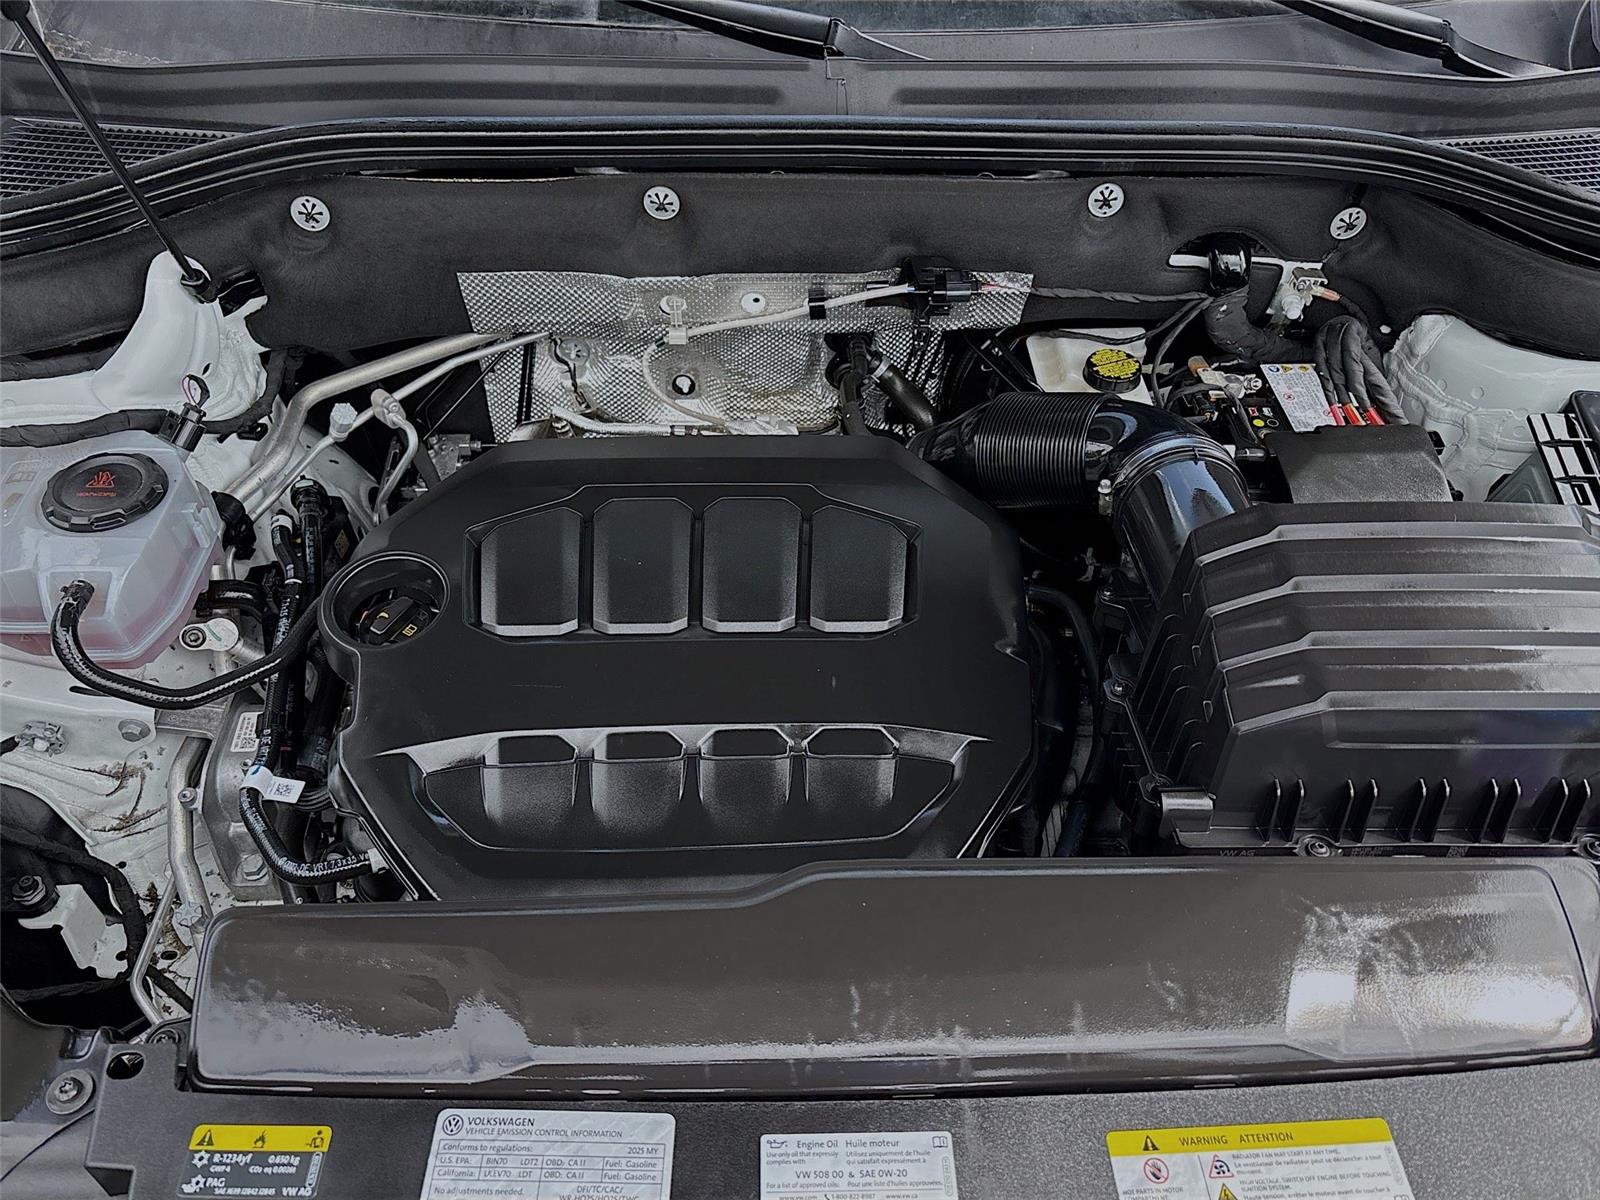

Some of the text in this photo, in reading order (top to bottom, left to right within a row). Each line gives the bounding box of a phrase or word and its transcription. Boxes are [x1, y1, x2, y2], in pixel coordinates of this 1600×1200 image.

[467, 1116, 535, 1127] VOLKSWAGEN
[465, 1127, 623, 1138] VEHICLE EMISSION CONTROL INFORMATION
[845, 1139, 900, 1148] Huile moteur
[1179, 1132, 1294, 1147] WARNING ATTENTION
[442, 1142, 533, 1153] Conforms to regulations:
[797, 1140, 838, 1150] Engine Oil
[628, 1146, 659, 1155] 2025 MY
[779, 1151, 790, 1159] only
[213, 1153, 253, 1166] R-1234yf
[290, 1155, 301, 1166] kg
[440, 1156, 472, 1165] U.S. EPA:
[485, 1157, 538, 1166] BIN70 LDT2
[545, 1159, 564, 1167] OBD:
[605, 1160, 657, 1169] Fuel: Gasoline
[437, 1168, 475, 1177] California:
[484, 1170, 533, 1178] ULEV70 LDT
[543, 1171, 563, 1179] OBD:
[603, 1172, 657, 1181] Fuel: Gasoline
[795, 1171, 812, 1179] VW
[813, 1170, 830, 1179] 508
[831, 1170, 844, 1179] 00
[859, 1169, 877, 1178] SAE
[878, 1169, 908, 1178] 0W-20
[206, 1177, 226, 1187] PAG
[282, 1186, 299, 1197] VW
[298, 1187, 313, 1197] AG
[433, 1186, 524, 1196] No adjustments needed.
